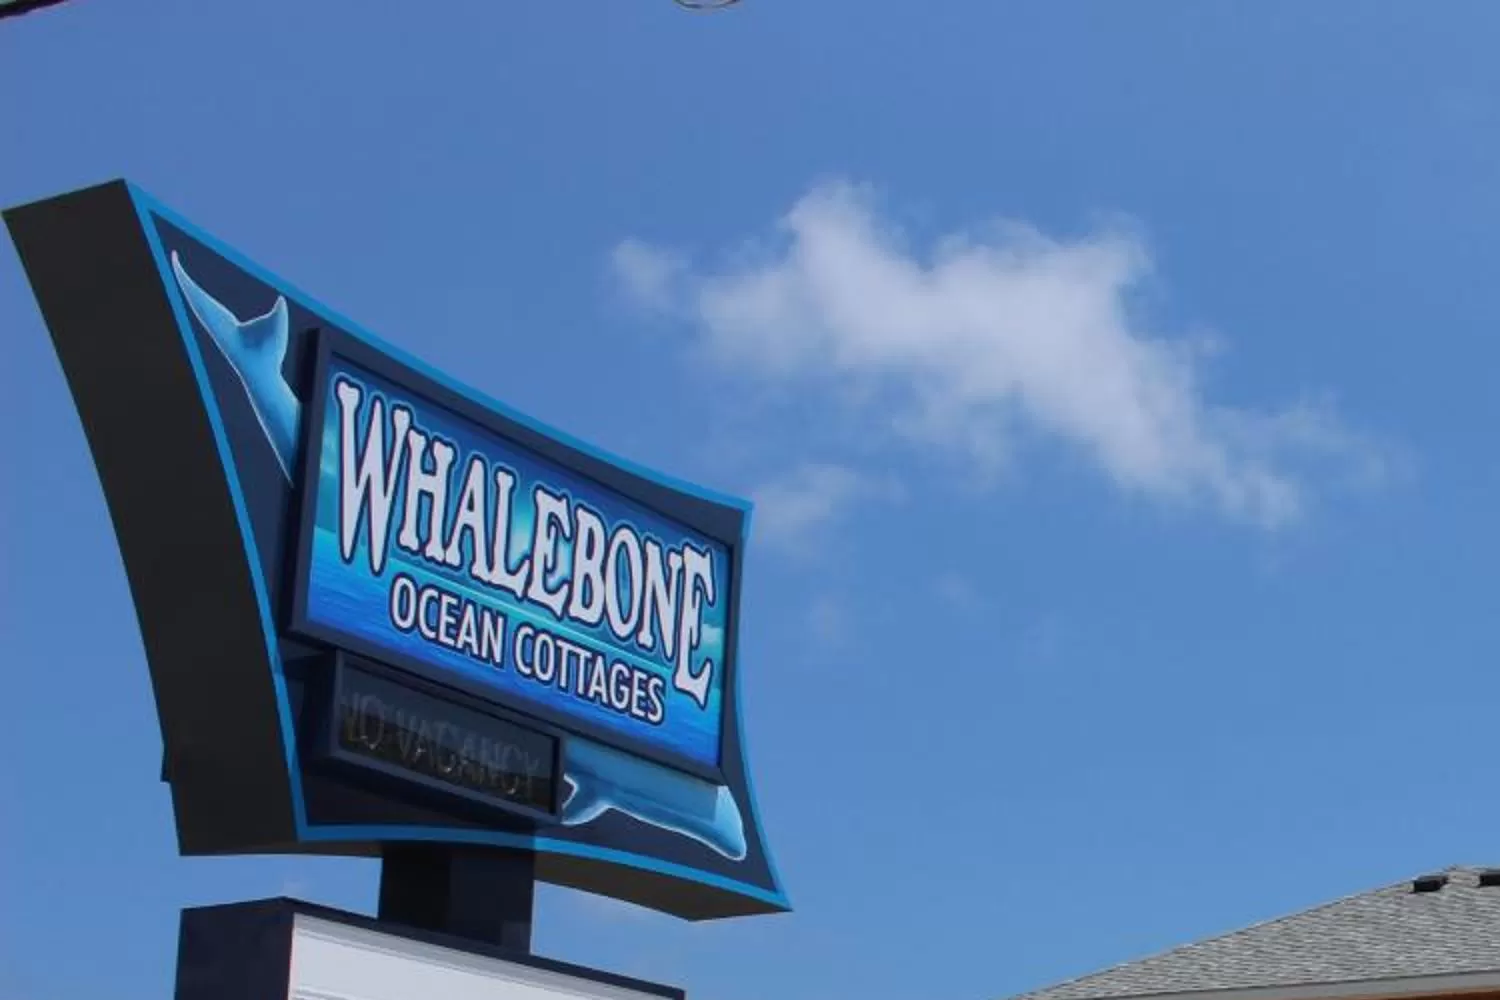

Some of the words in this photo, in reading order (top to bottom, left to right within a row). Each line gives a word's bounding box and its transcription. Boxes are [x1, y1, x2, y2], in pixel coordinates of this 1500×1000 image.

[336, 380, 716, 709] WHALEBONE
[391, 577, 504, 664] OCEAN
[515, 626, 666, 724] COTTAGES
